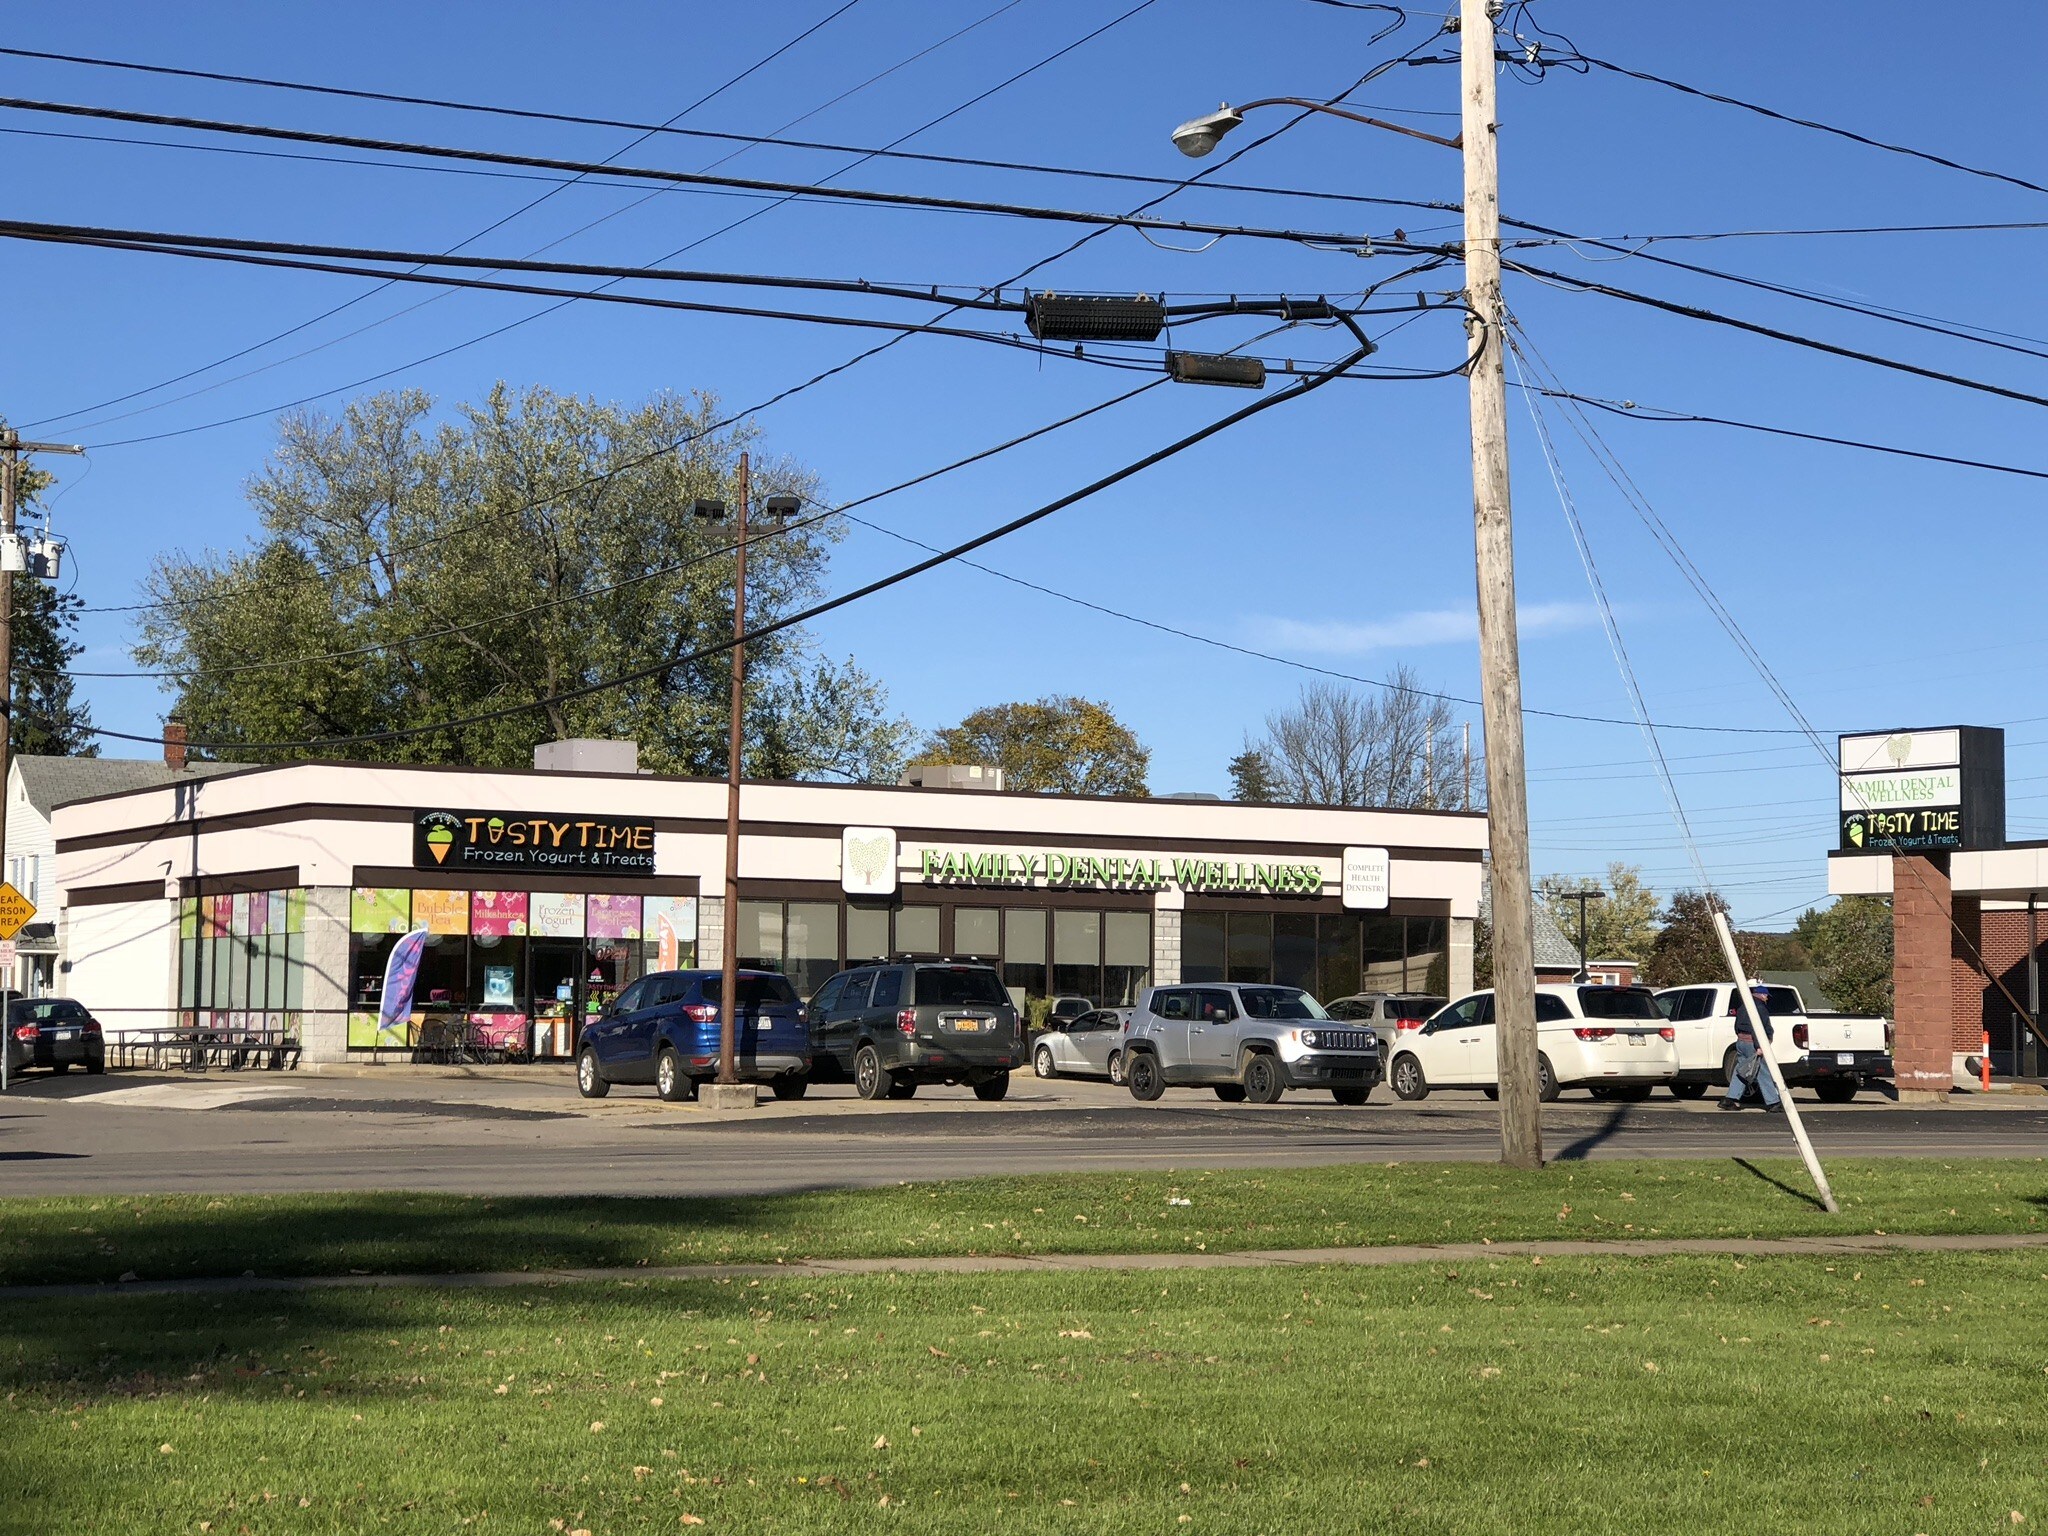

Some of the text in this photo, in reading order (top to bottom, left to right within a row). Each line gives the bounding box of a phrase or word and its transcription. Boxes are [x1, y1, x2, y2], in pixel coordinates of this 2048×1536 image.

[1849, 776, 1954, 793] FAMILY DENTAL
[1867, 789, 1934, 803] WELLNESS
[1921, 811, 1960, 831] TIME
[465, 817, 570, 847] TASTY
[575, 821, 653, 850] TIME
[1869, 833, 1959, 847] Frozen Yogurt & Treats
[464, 846, 654, 866] Frozen Yogurt & Treats
[921, 848, 1322, 889] FAMILY DENTAL WELLNESS
[1347, 863, 1385, 872] COMPLETE
[1351, 874, 1380, 882] HEALTH
[1346, 884, 1385, 892] DENTISTRY
[418, 902, 464, 913] Bubble
[474, 908, 525, 919] Milkshakes
[539, 904, 575, 915] Frozen
[429, 914, 451, 925] Tea
[540, 914, 574, 928] Yogurt
